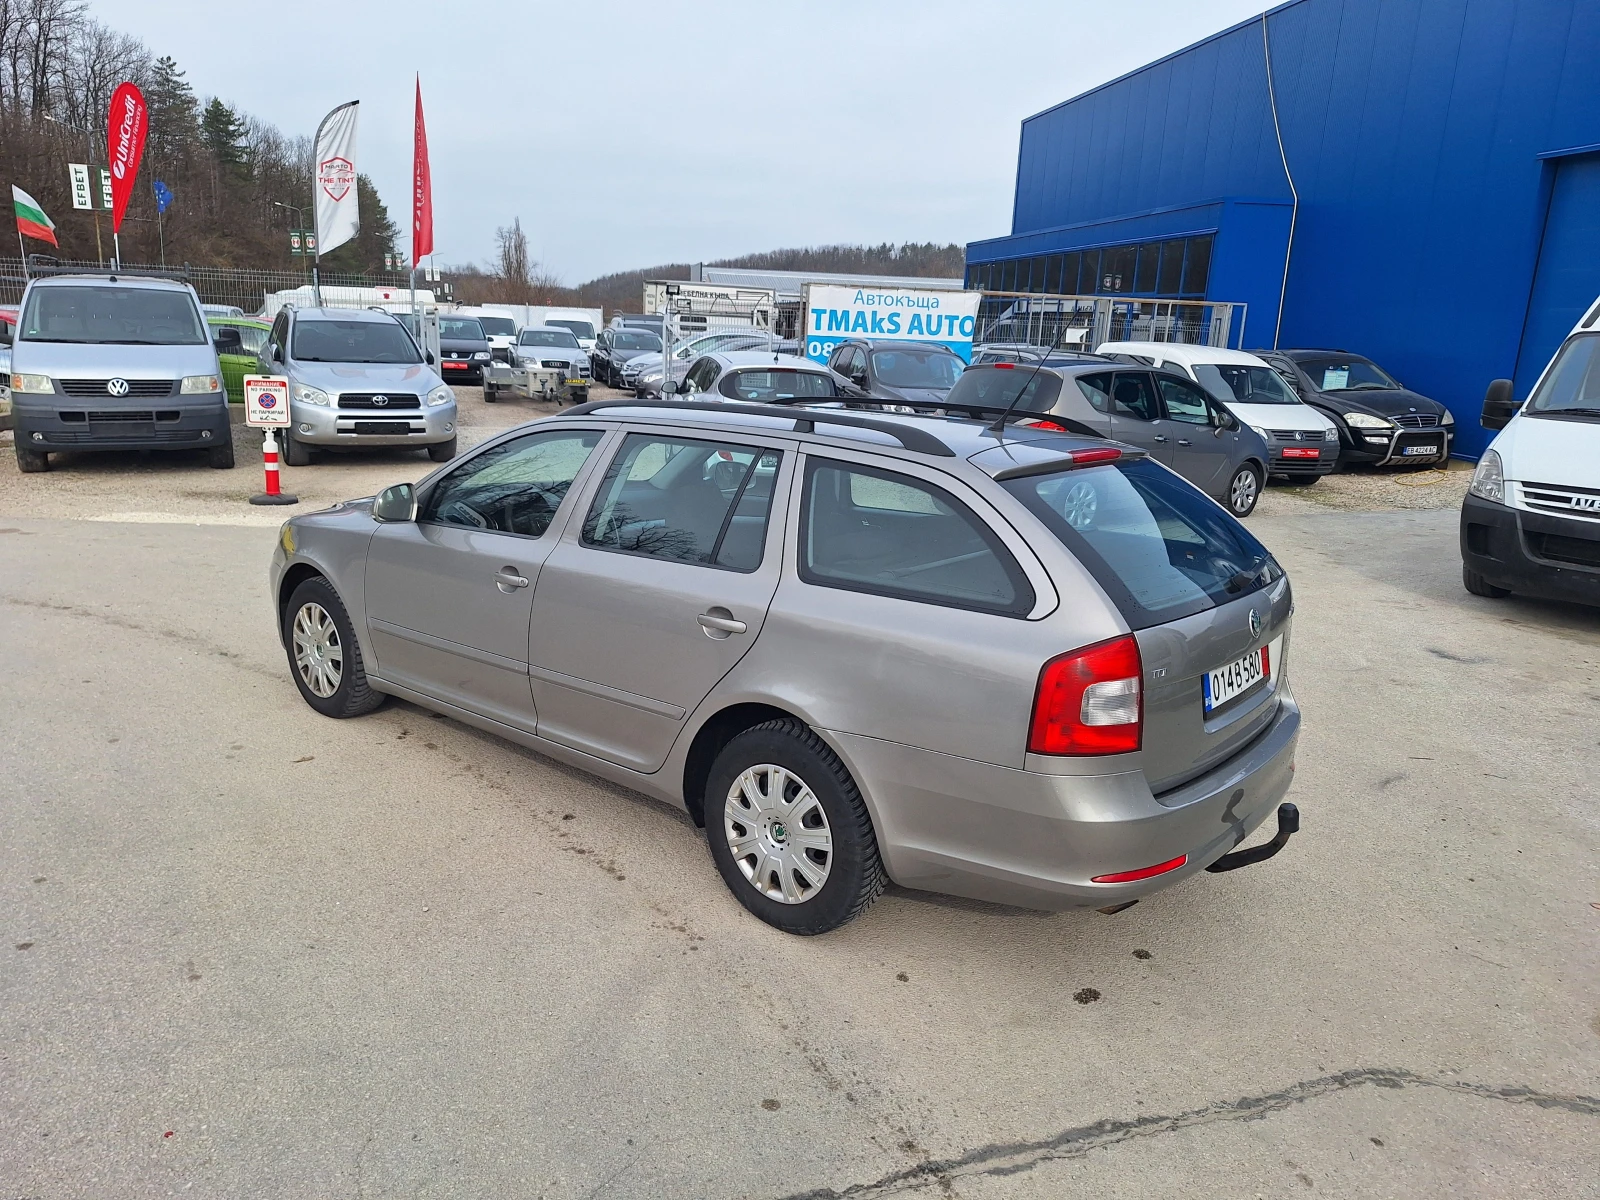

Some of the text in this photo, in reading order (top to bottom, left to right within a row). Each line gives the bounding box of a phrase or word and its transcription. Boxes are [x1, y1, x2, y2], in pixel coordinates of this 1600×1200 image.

[117, 94, 136, 163] UniCredit
[128, 104, 143, 168] Consumer Financing
[75, 168, 86, 206] EFBET
[101, 169, 113, 208] EFBET
[853, 290, 939, 311] Автокъща
[811, 308, 974, 337] TMAkS AUTO
[1152, 667, 1167, 678] TDI
